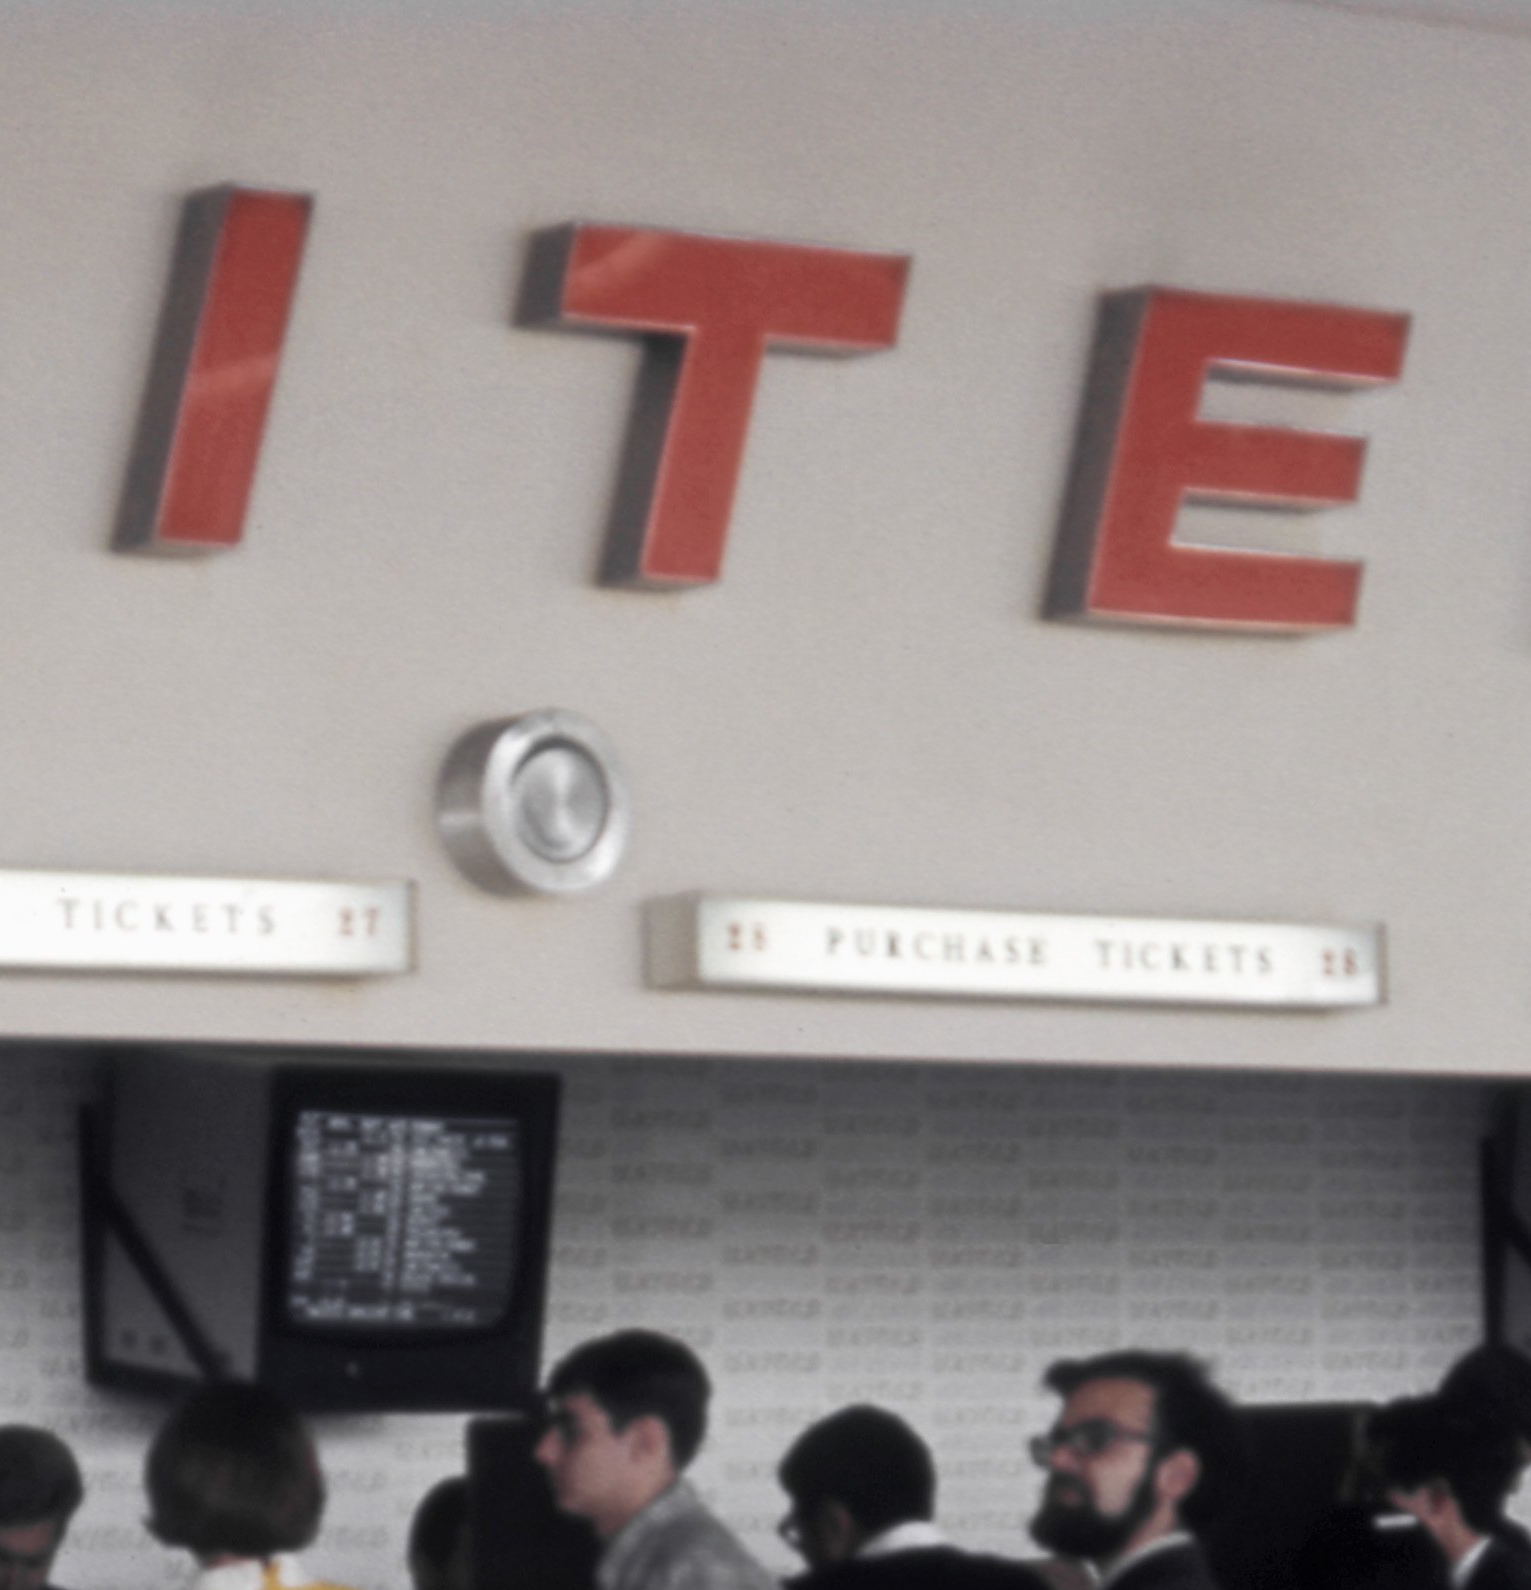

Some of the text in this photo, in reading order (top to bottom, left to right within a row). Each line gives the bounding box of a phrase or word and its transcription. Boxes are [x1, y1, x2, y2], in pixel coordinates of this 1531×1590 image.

[56, 895, 278, 936] TICKETS
[337, 905, 382, 939] 27
[825, 925, 1048, 968] PURCHASE
[1094, 938, 1274, 976] TICKETS
